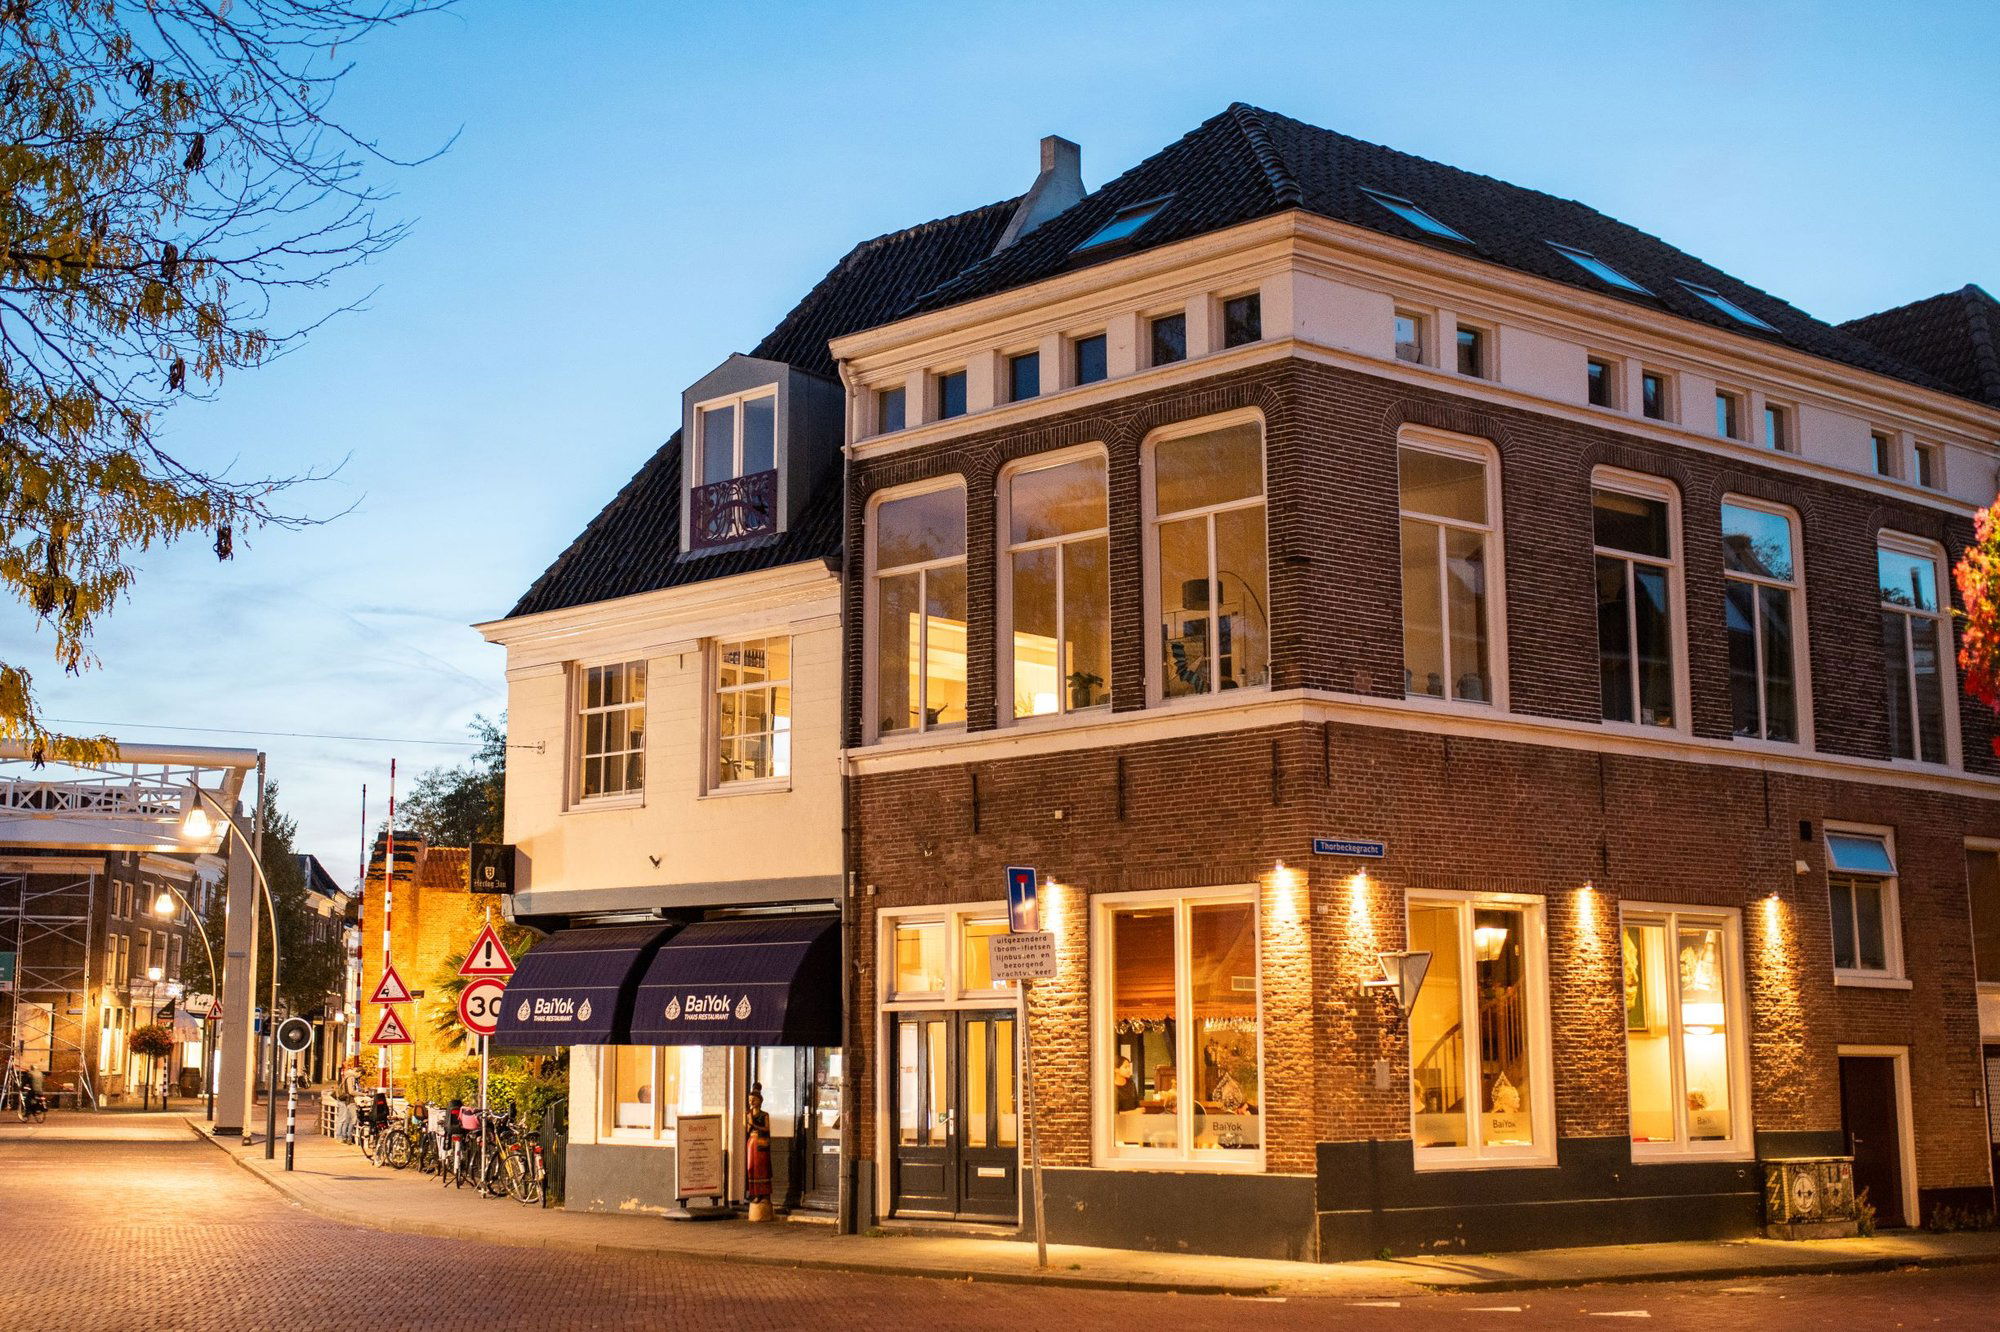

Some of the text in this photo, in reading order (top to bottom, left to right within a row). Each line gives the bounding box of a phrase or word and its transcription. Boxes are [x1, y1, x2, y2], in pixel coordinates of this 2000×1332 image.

[1320, 842, 1379, 853] Thorbeckegracht
[996, 936, 1047, 944] uitgezonderd
[1004, 961, 1044, 969] bezorgend
[469, 996, 502, 1017] 30
[534, 998, 574, 1014] BaiYok
[685, 995, 731, 1012] BaiYok
[1212, 1121, 1243, 1131] BaiYok
